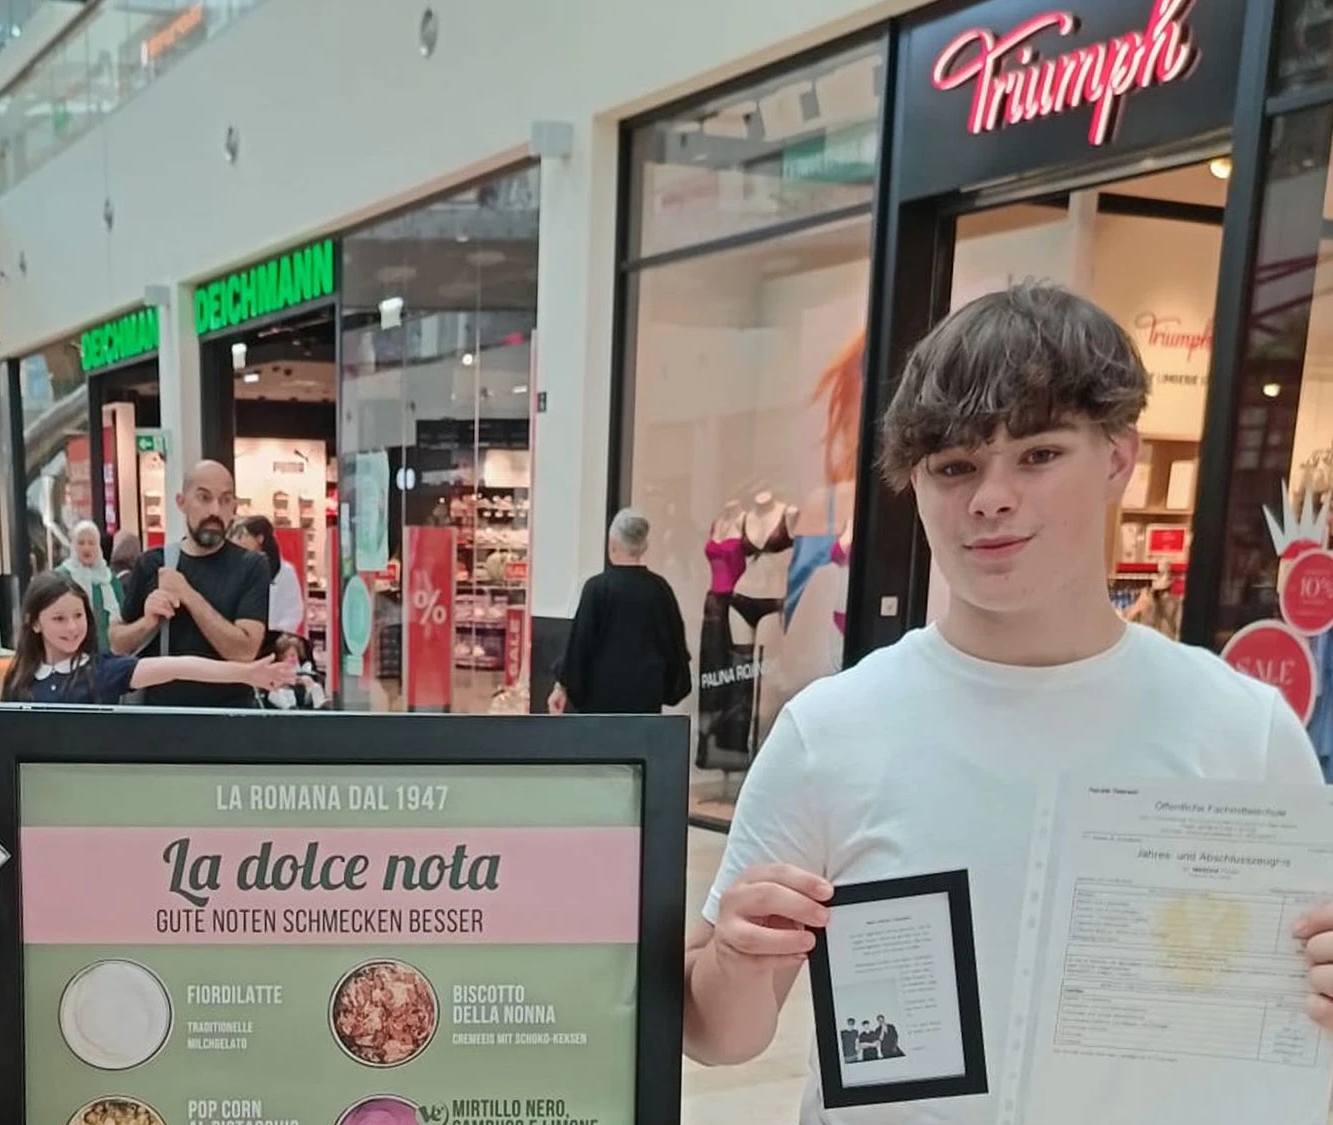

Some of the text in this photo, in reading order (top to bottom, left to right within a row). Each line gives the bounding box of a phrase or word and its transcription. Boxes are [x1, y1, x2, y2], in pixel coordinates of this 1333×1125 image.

[933, 0, 1191, 145] Triumph
[194, 238, 333, 335] DEICHMANN
[217, 785, 448, 811] LA ROMANA DAL 1947
[162, 838, 502, 907] La dolce nota
[156, 909, 484, 934] GUTE NOTEN SCHMECKEN BESSER
[187, 985, 283, 1005] FIORDILATTE
[453, 985, 525, 1004] BISCOTTO
[453, 1005, 556, 1024] DELLA NONNA
[187, 1021, 253, 1034] TRADITIONELLE
[187, 1038, 247, 1050] MILCHGELATO
[497, 1033, 513, 1045] MIT
[515, 1033, 587, 1045] SCHOKO-KEKSEN
[188, 1100, 262, 1118] POP CORN
[452, 1100, 570, 1120] MIRTILLO NERO,
